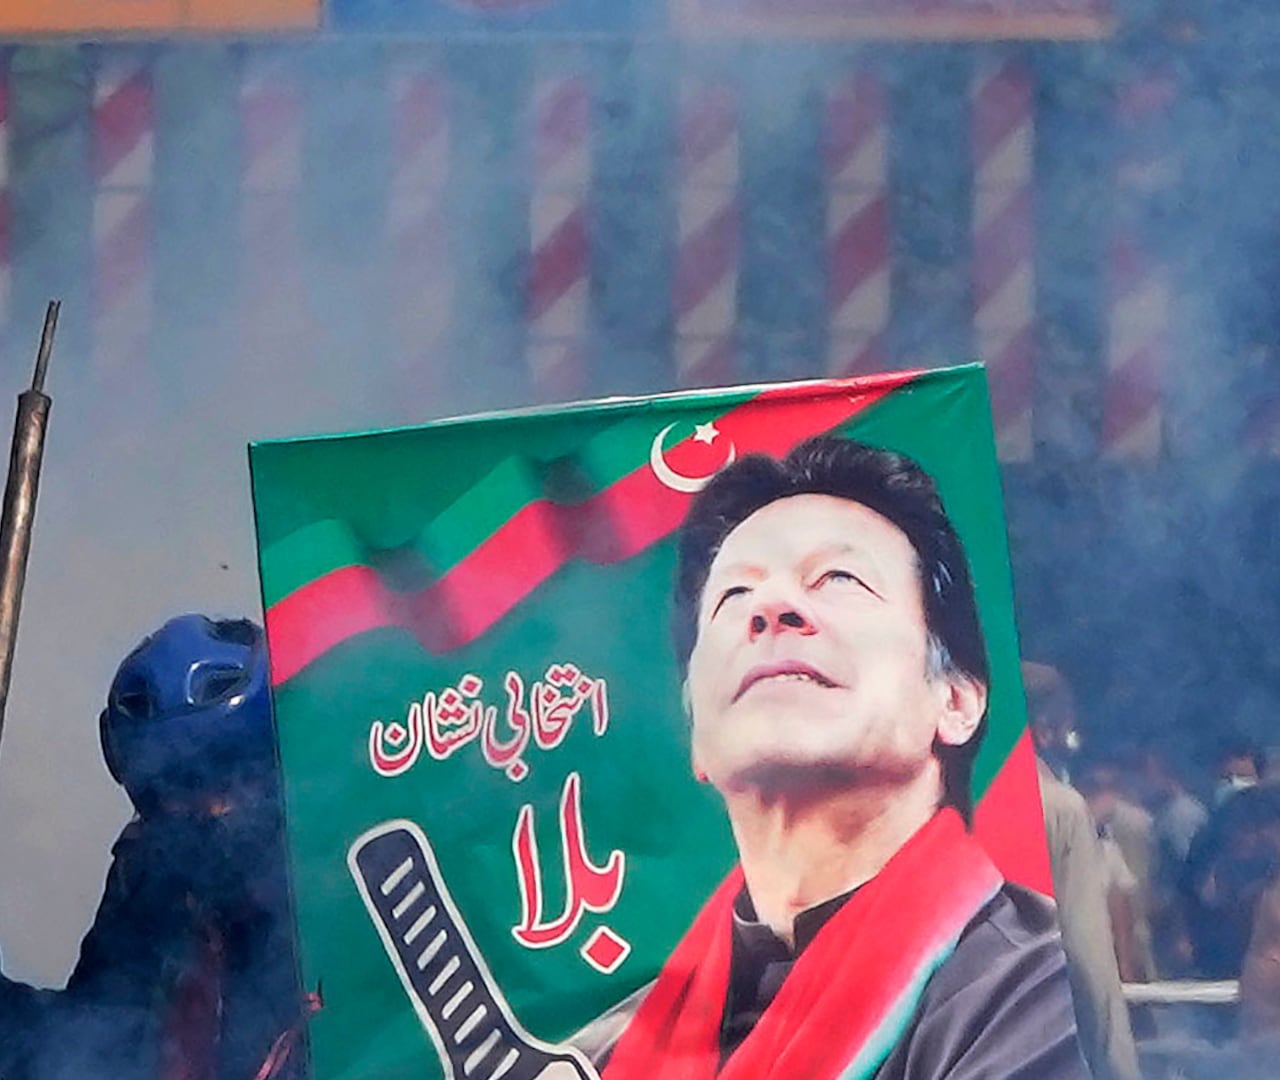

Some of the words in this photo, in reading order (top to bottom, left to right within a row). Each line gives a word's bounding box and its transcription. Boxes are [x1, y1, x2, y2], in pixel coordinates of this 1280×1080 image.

[369, 674, 483, 777] نشان
[482, 663, 609, 781] انتخابی
[511, 771, 632, 974] بلا
